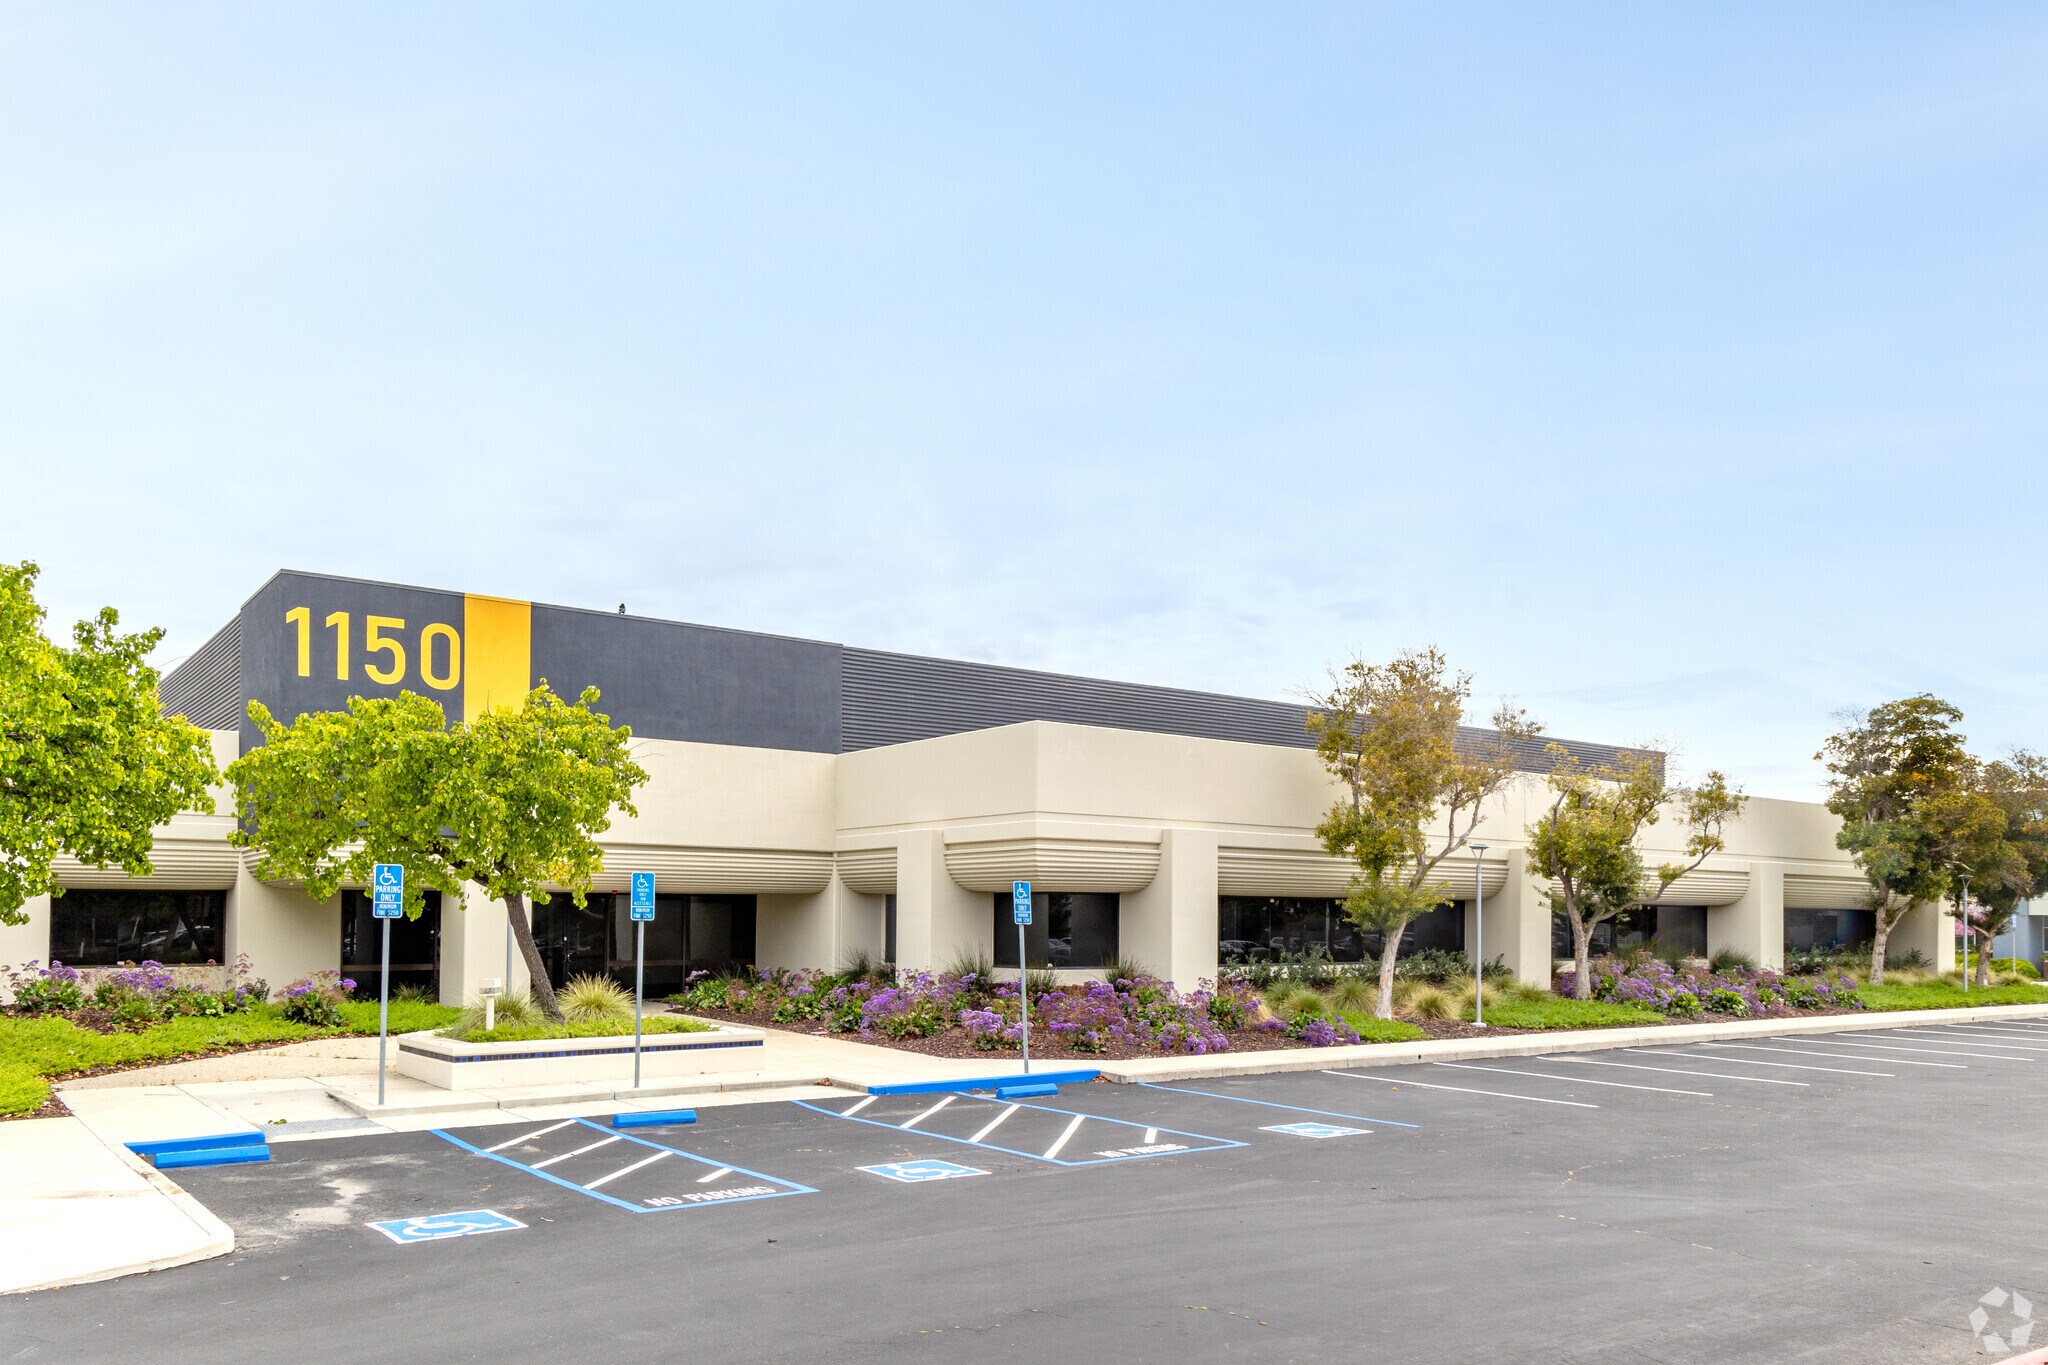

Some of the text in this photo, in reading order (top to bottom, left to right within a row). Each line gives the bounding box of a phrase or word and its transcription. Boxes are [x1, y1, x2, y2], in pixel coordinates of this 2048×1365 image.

[286, 606, 460, 690] 1150
[376, 885, 401, 893] PARKING
[381, 894, 396, 902] ONLY
[643, 1186, 777, 1207] NO PARKING
